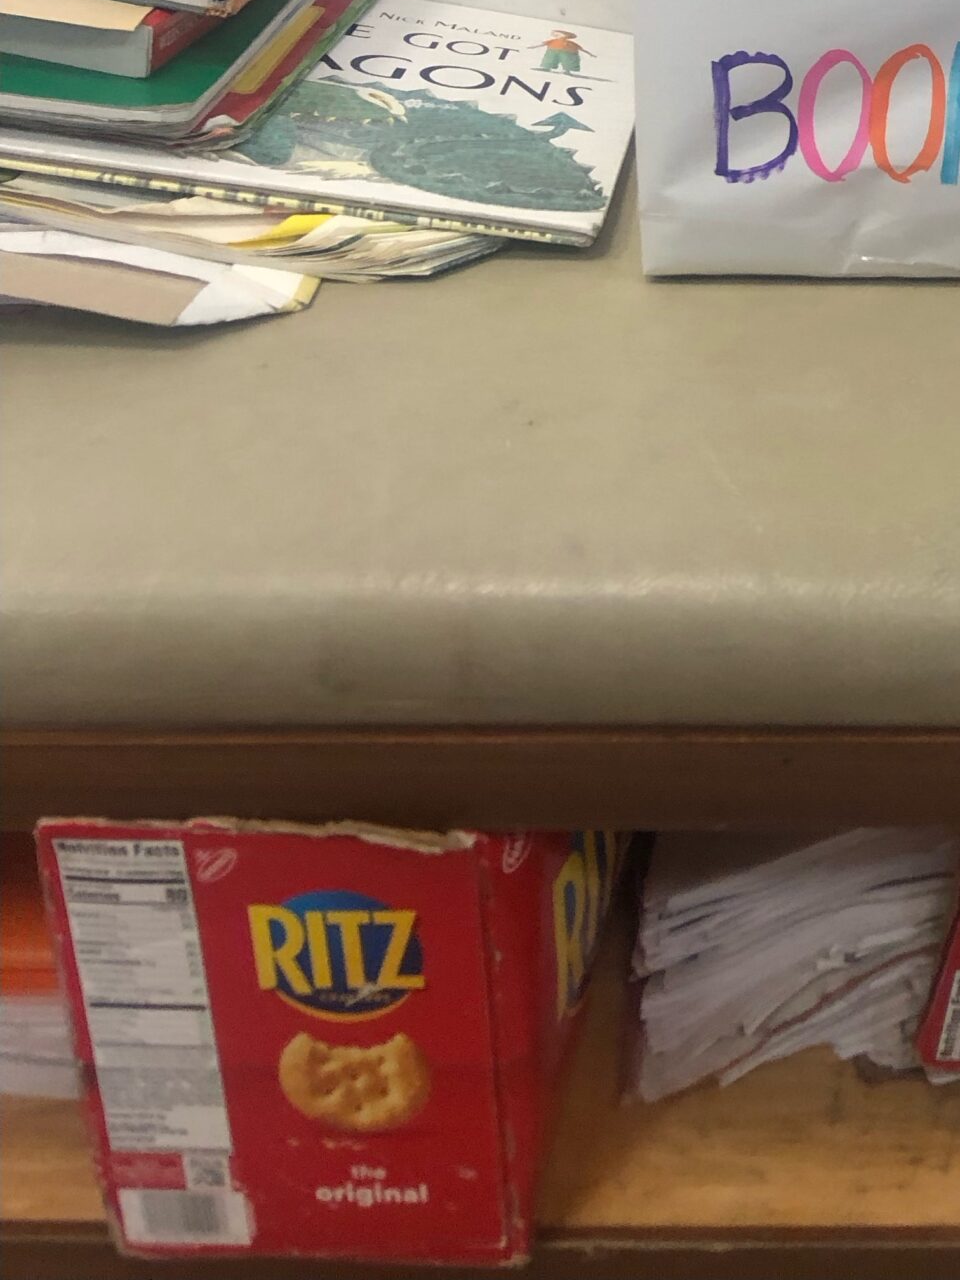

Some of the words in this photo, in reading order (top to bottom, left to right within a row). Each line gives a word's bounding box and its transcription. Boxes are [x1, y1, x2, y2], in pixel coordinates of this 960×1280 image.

[379, 11, 425, 26] NICK
[434, 20, 522, 41] MALAND
[402, 32, 520, 61] GOT
[247, 903, 426, 996] RITZ
[350, 1164, 387, 1180] the
[315, 1181, 429, 1208] original
